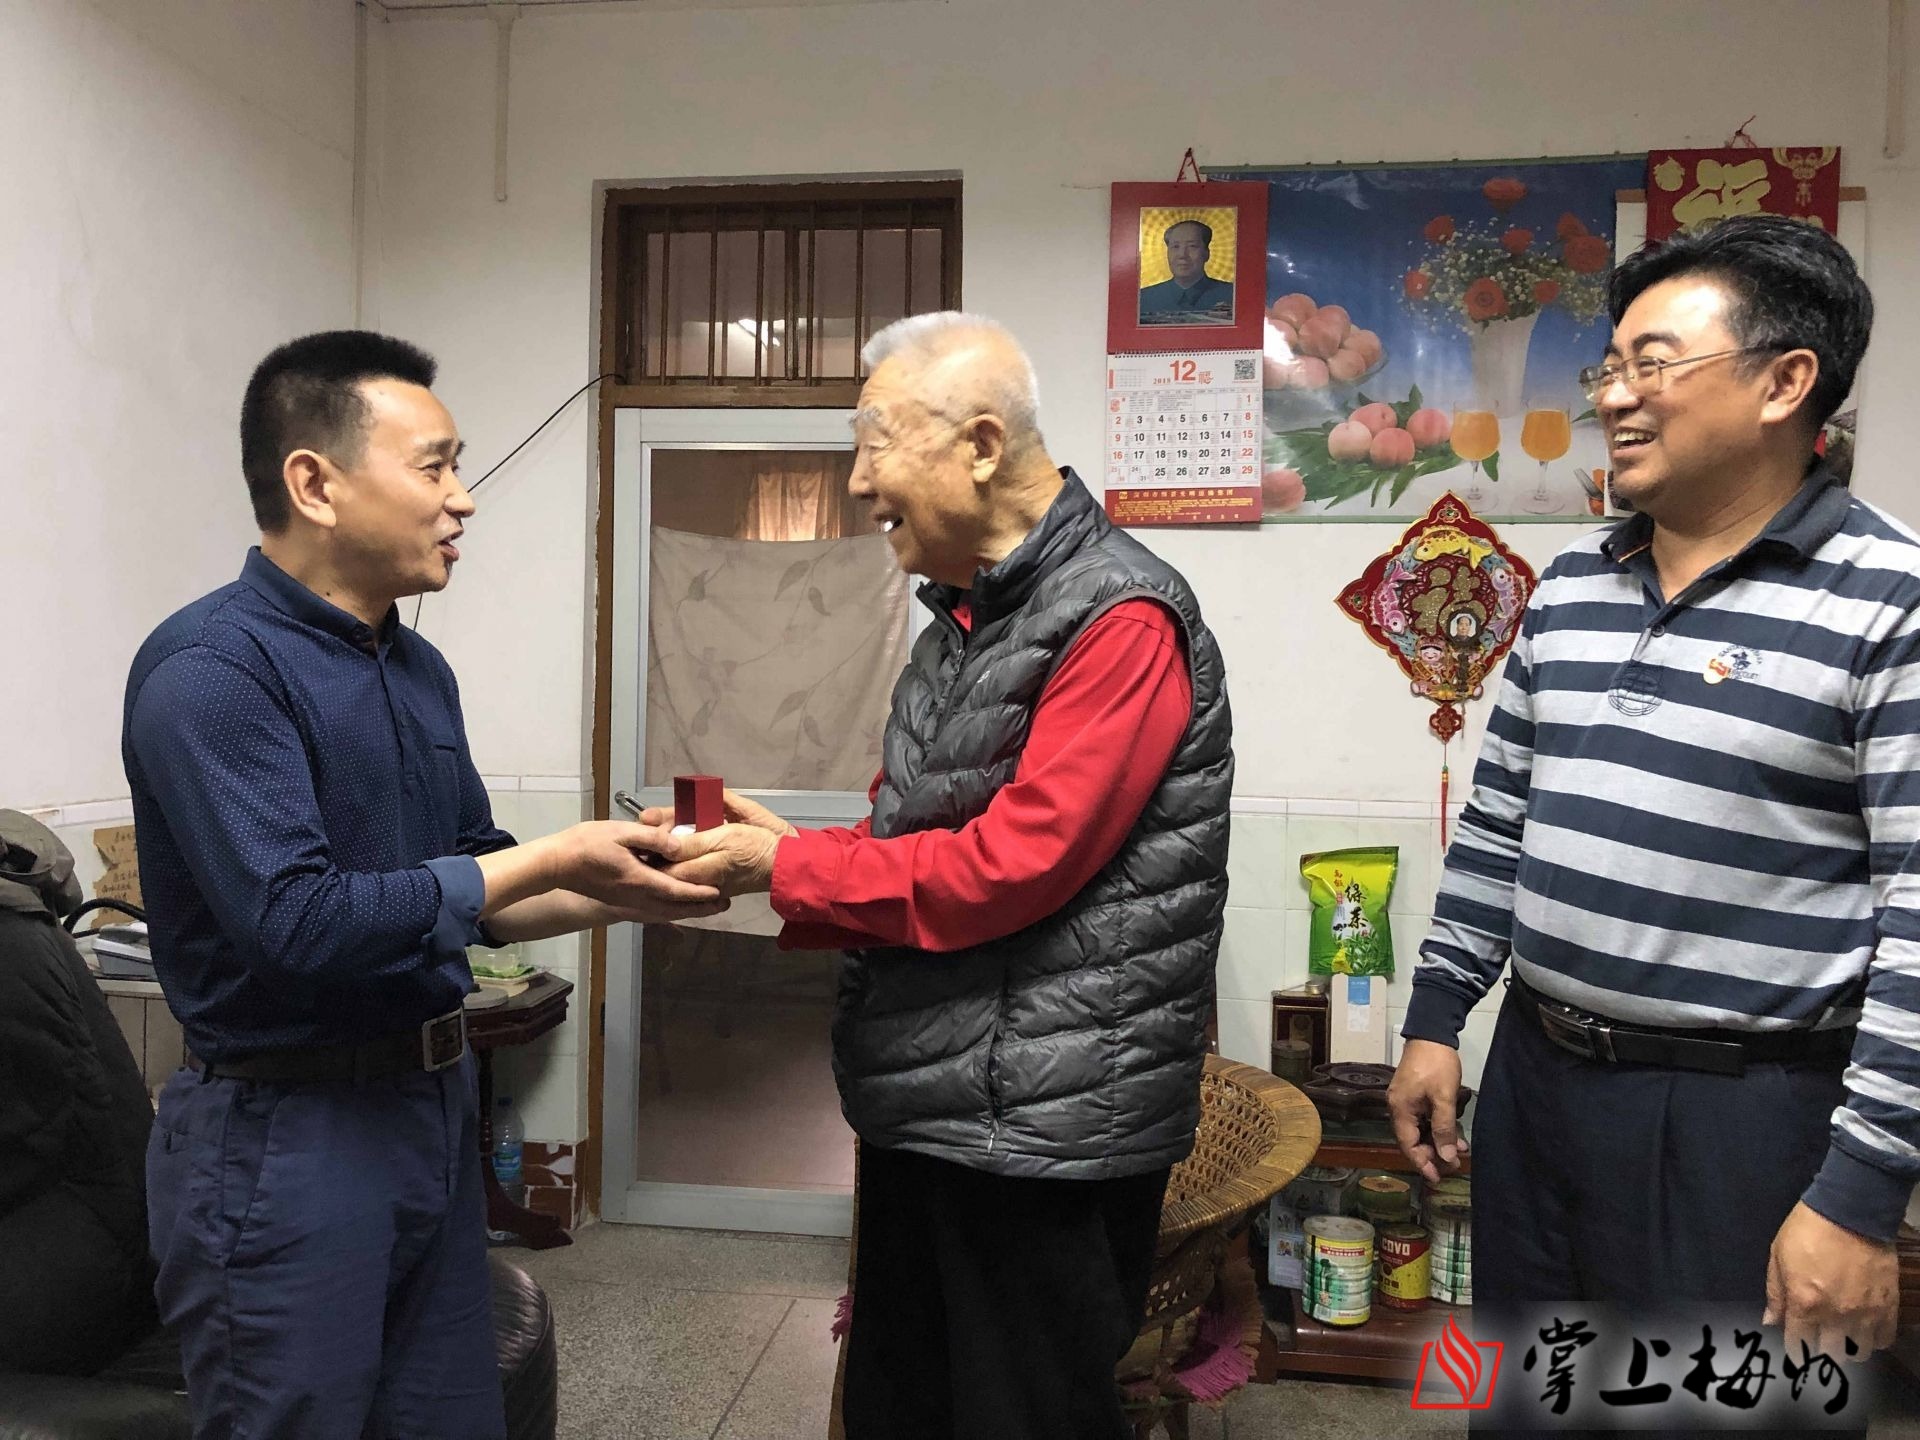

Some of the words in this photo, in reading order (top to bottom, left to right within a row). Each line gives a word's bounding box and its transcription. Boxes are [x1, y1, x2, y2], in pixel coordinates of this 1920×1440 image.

[1169, 360, 1197, 381] 12
[1115, 416, 1121, 424] 2
[1137, 415, 1143, 424] 3
[1158, 414, 1164, 423] 4
[1180, 414, 1186, 422] 5
[1202, 414, 1208, 422] 6
[1223, 413, 1229, 421] 7
[1245, 412, 1251, 420] 8
[1115, 434, 1121, 442] 9
[1134, 433, 1145, 441] 10
[1157, 432, 1166, 441] 11
[1177, 432, 1188, 440] 12
[1200, 431, 1210, 440] 13
[1221, 430, 1231, 439] 14
[1243, 430, 1253, 438] 15
[1113, 451, 1122, 460] 16
[1134, 450, 1144, 459] 17
[1156, 450, 1166, 458] 18
[1177, 450, 1188, 458] 19
[1199, 449, 1210, 458] 20
[1221, 448, 1231, 457] 21
[1242, 448, 1253, 457] 22
[1155, 468, 1166, 476] 25
[1176, 467, 1188, 476] 26
[1198, 467, 1209, 475] 27
[1220, 466, 1231, 475] 28
[1242, 466, 1253, 474] 29
[1345, 883, 1368, 929] 绿茶
[1382, 1238, 1411, 1256] COVO
